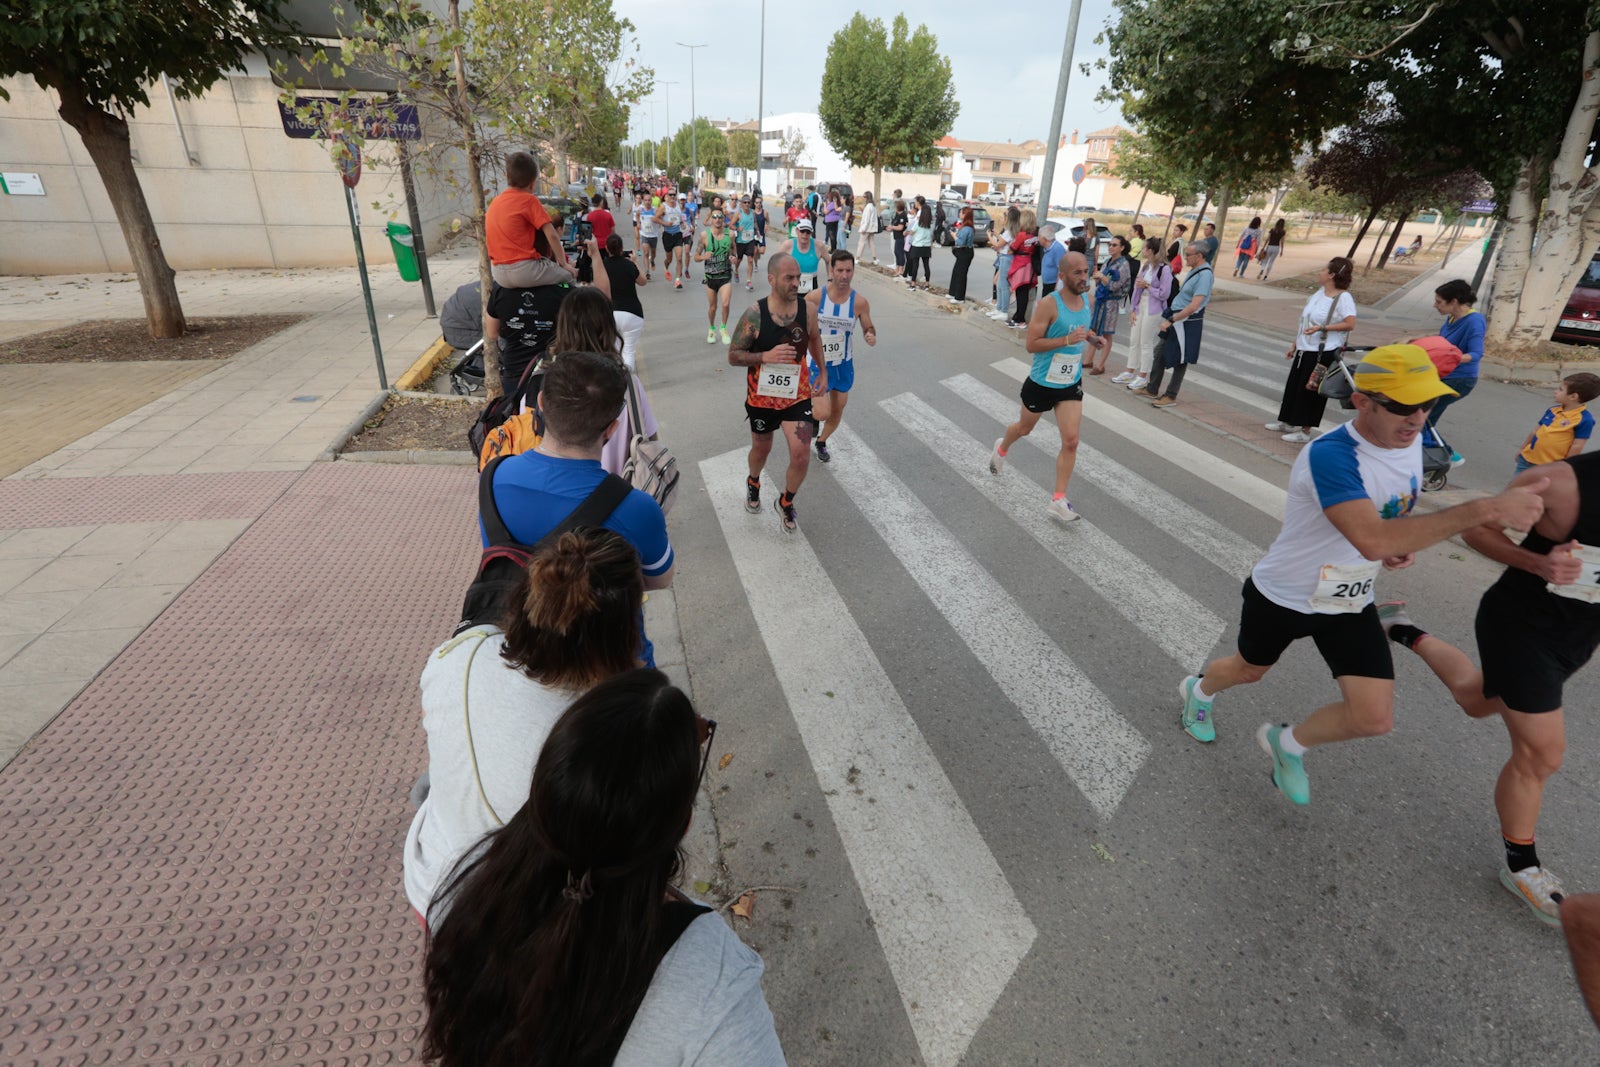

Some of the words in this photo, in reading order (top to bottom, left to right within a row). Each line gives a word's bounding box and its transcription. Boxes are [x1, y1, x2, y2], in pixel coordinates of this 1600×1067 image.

[822, 342, 840, 353] 130
[1060, 364, 1073, 374] 93
[768, 374, 791, 387] 365
[1332, 579, 1372, 597] 206
